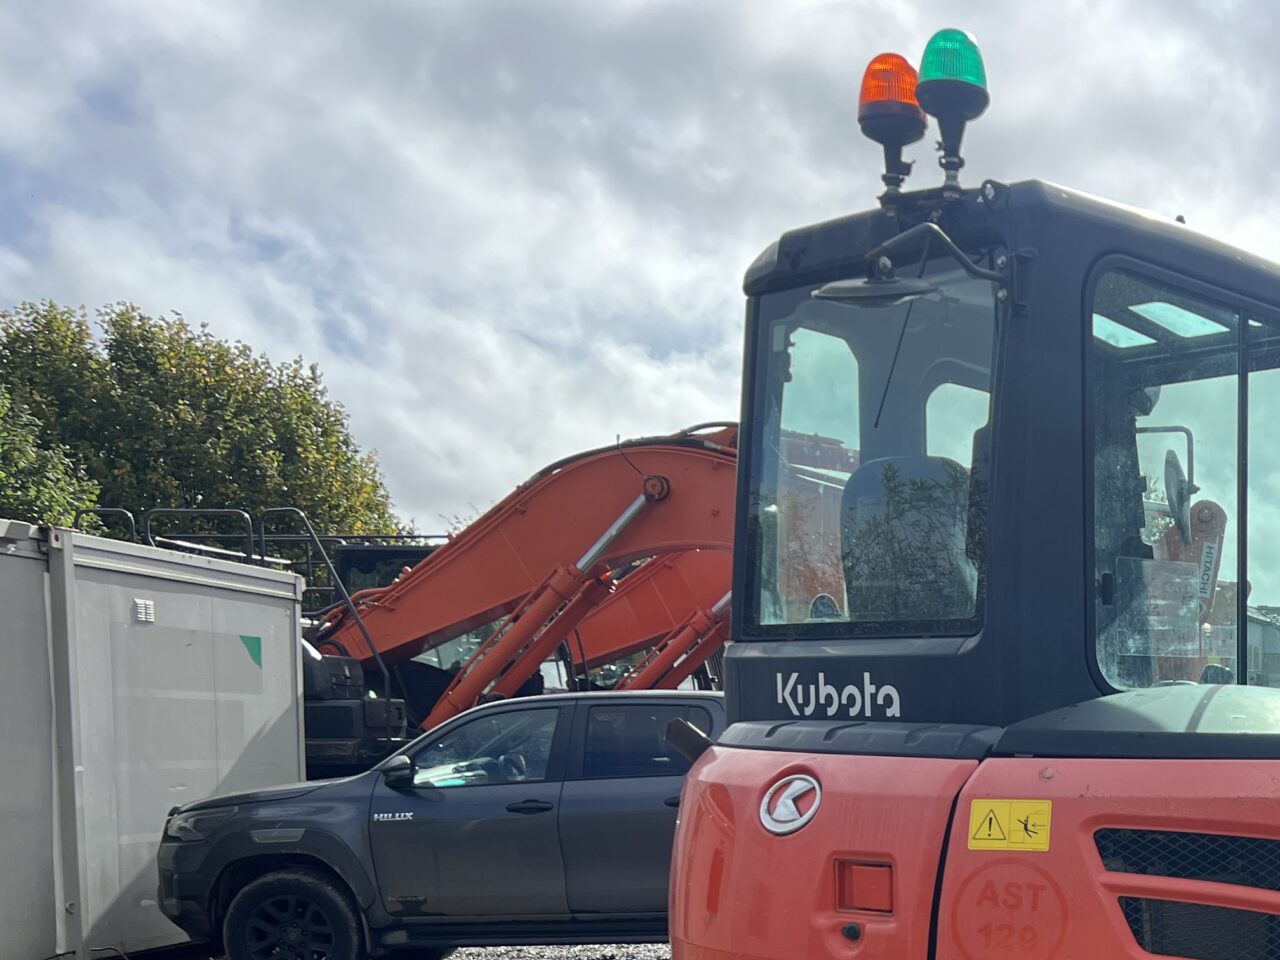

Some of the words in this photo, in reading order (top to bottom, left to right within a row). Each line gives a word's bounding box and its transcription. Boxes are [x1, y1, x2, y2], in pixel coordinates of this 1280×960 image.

[1200, 545, 1215, 595] HITACHI
[776, 672, 900, 717] Kubota
[373, 812, 414, 821] HILUX
[976, 880, 1047, 912] AST
